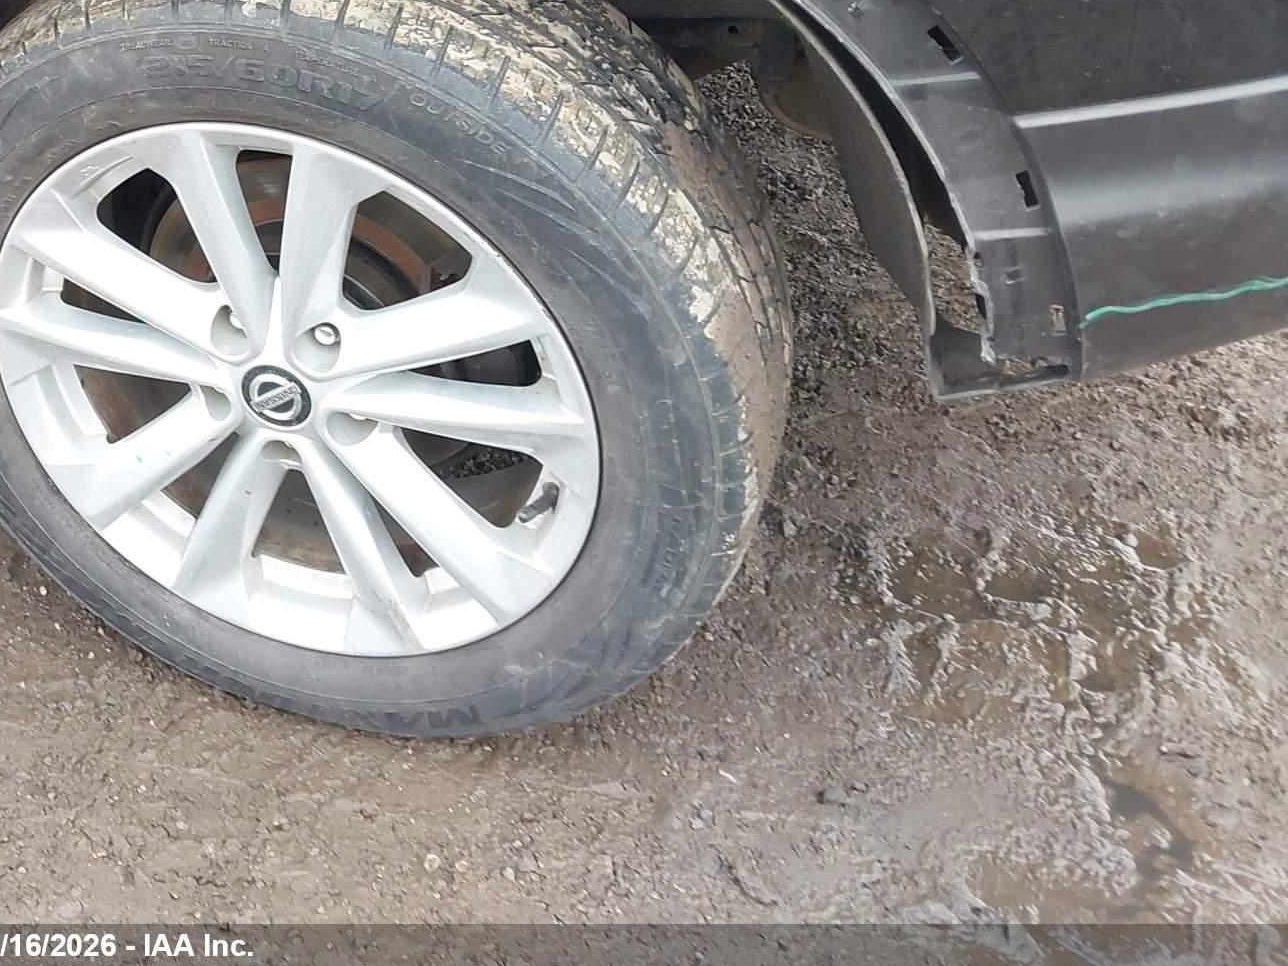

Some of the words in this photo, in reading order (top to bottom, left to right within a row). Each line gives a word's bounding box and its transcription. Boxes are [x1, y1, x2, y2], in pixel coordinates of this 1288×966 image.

[208, 37, 254, 51] TRACTION
[408, 93, 513, 156] OUTSIDE
[253, 384, 301, 413] NISSAN
